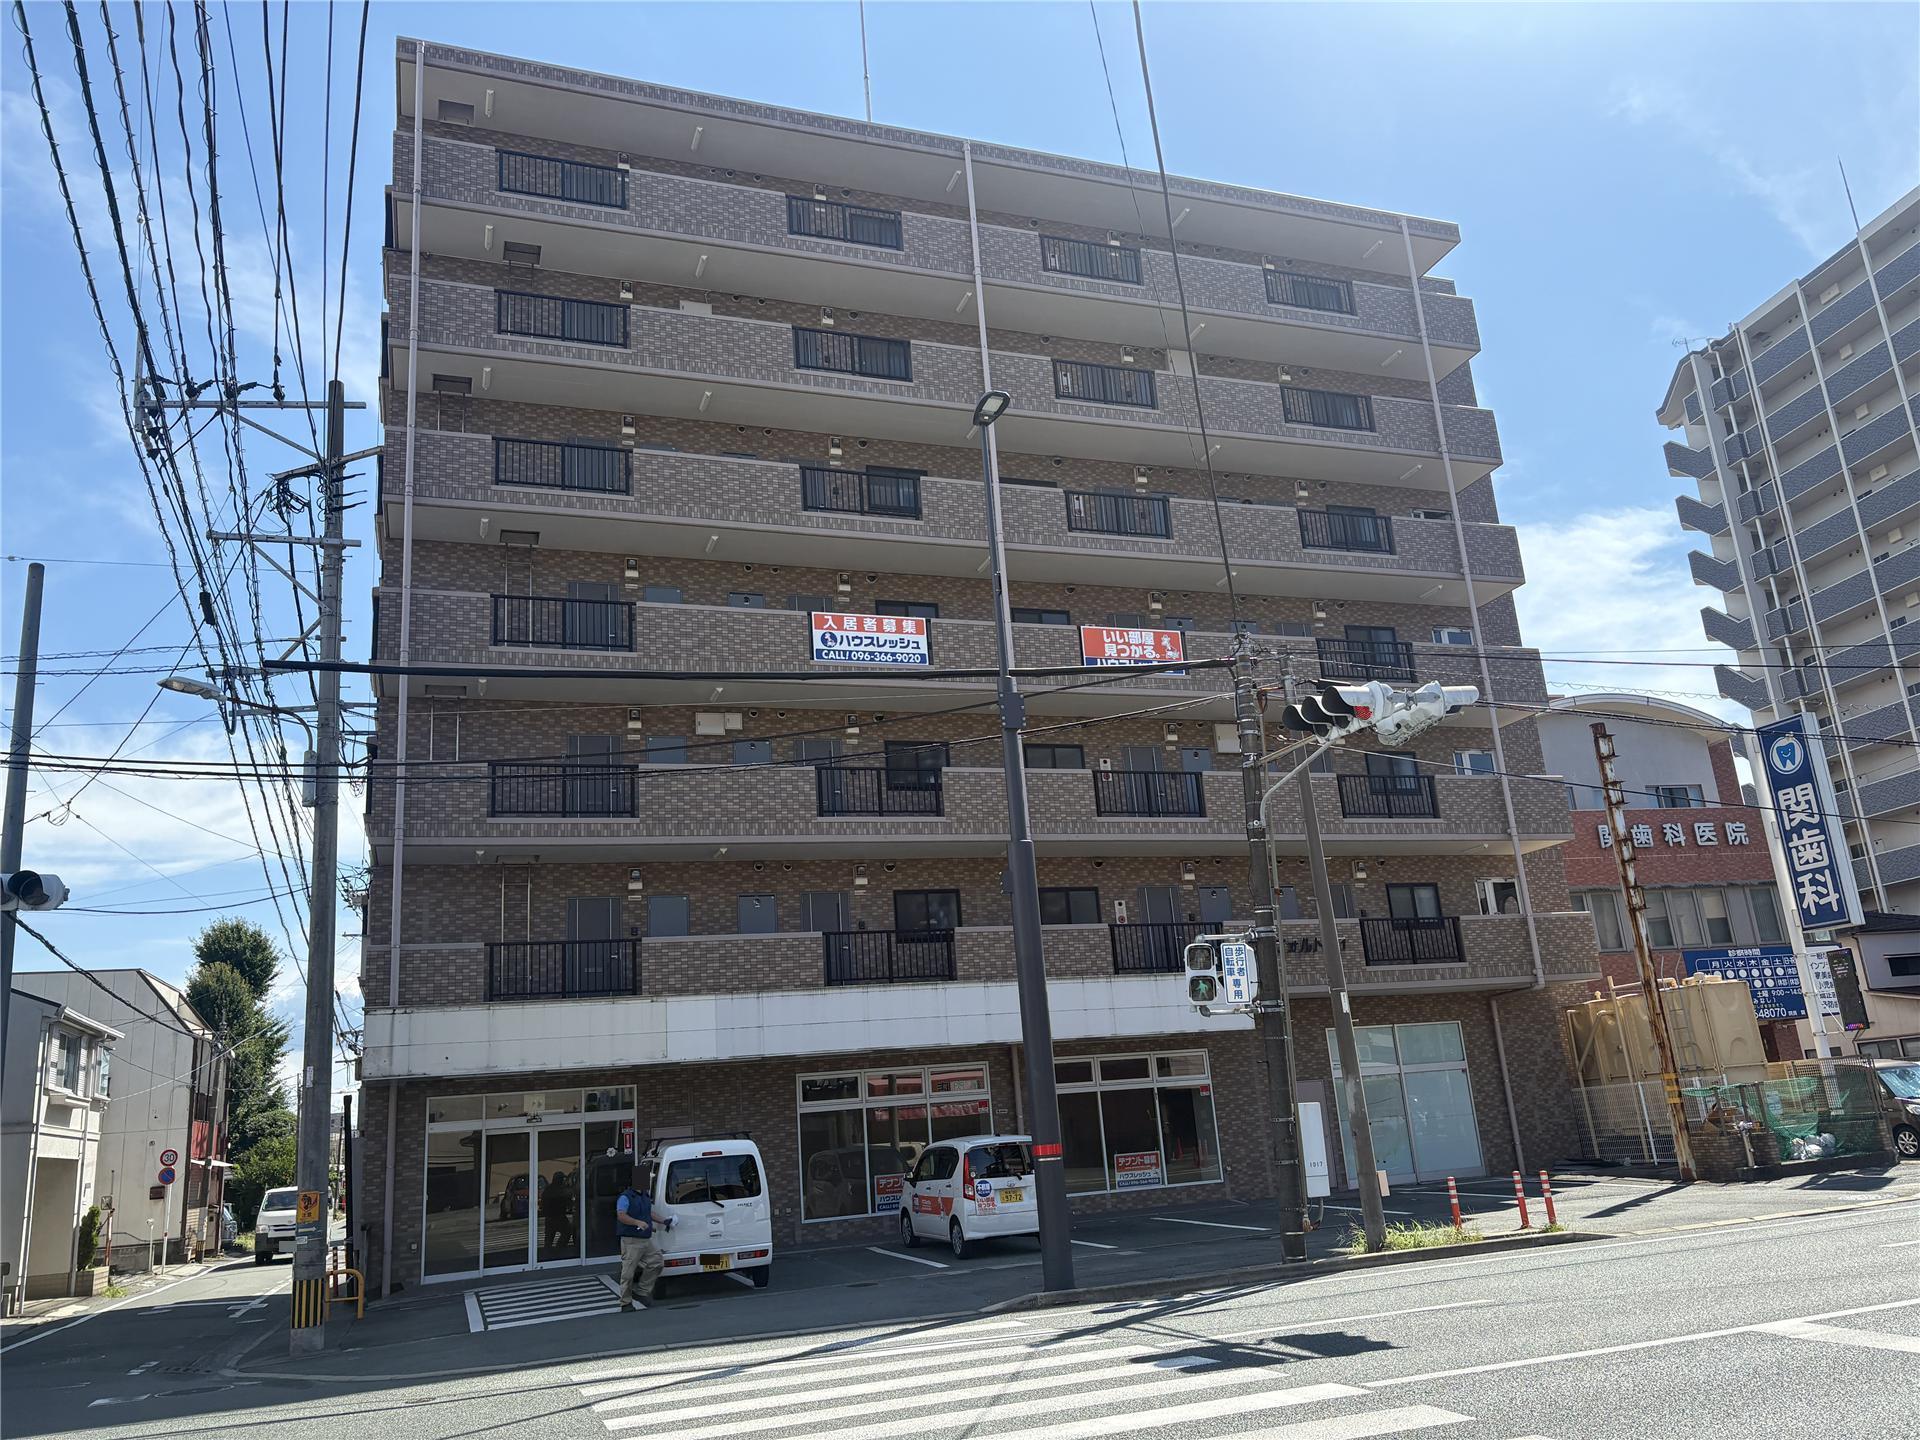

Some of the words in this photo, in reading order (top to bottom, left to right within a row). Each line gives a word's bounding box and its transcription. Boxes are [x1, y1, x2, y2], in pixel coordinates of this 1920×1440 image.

[823, 615, 917, 634] 入居者募集
[839, 634, 921, 650] ハウスレッシュ
[1102, 629, 1155, 645] いい部屋
[821, 650, 849, 660] CALL!
[851, 651, 921, 663] 096-366-9020
[1104, 643, 1160, 658] 見つかる。
[1778, 782, 1839, 916] 関歯科
[1225, 946, 1236, 977] 自転車
[1235, 946, 1245, 977] 歩行者
[1711, 961, 1720, 969] 月
[1748, 959, 1758, 967] 木
[1761, 958, 1770, 966] 金
[1774, 957, 1782, 965] 土
[1232, 978, 1243, 1000] 専用
[164, 1153, 175, 1162] 30
